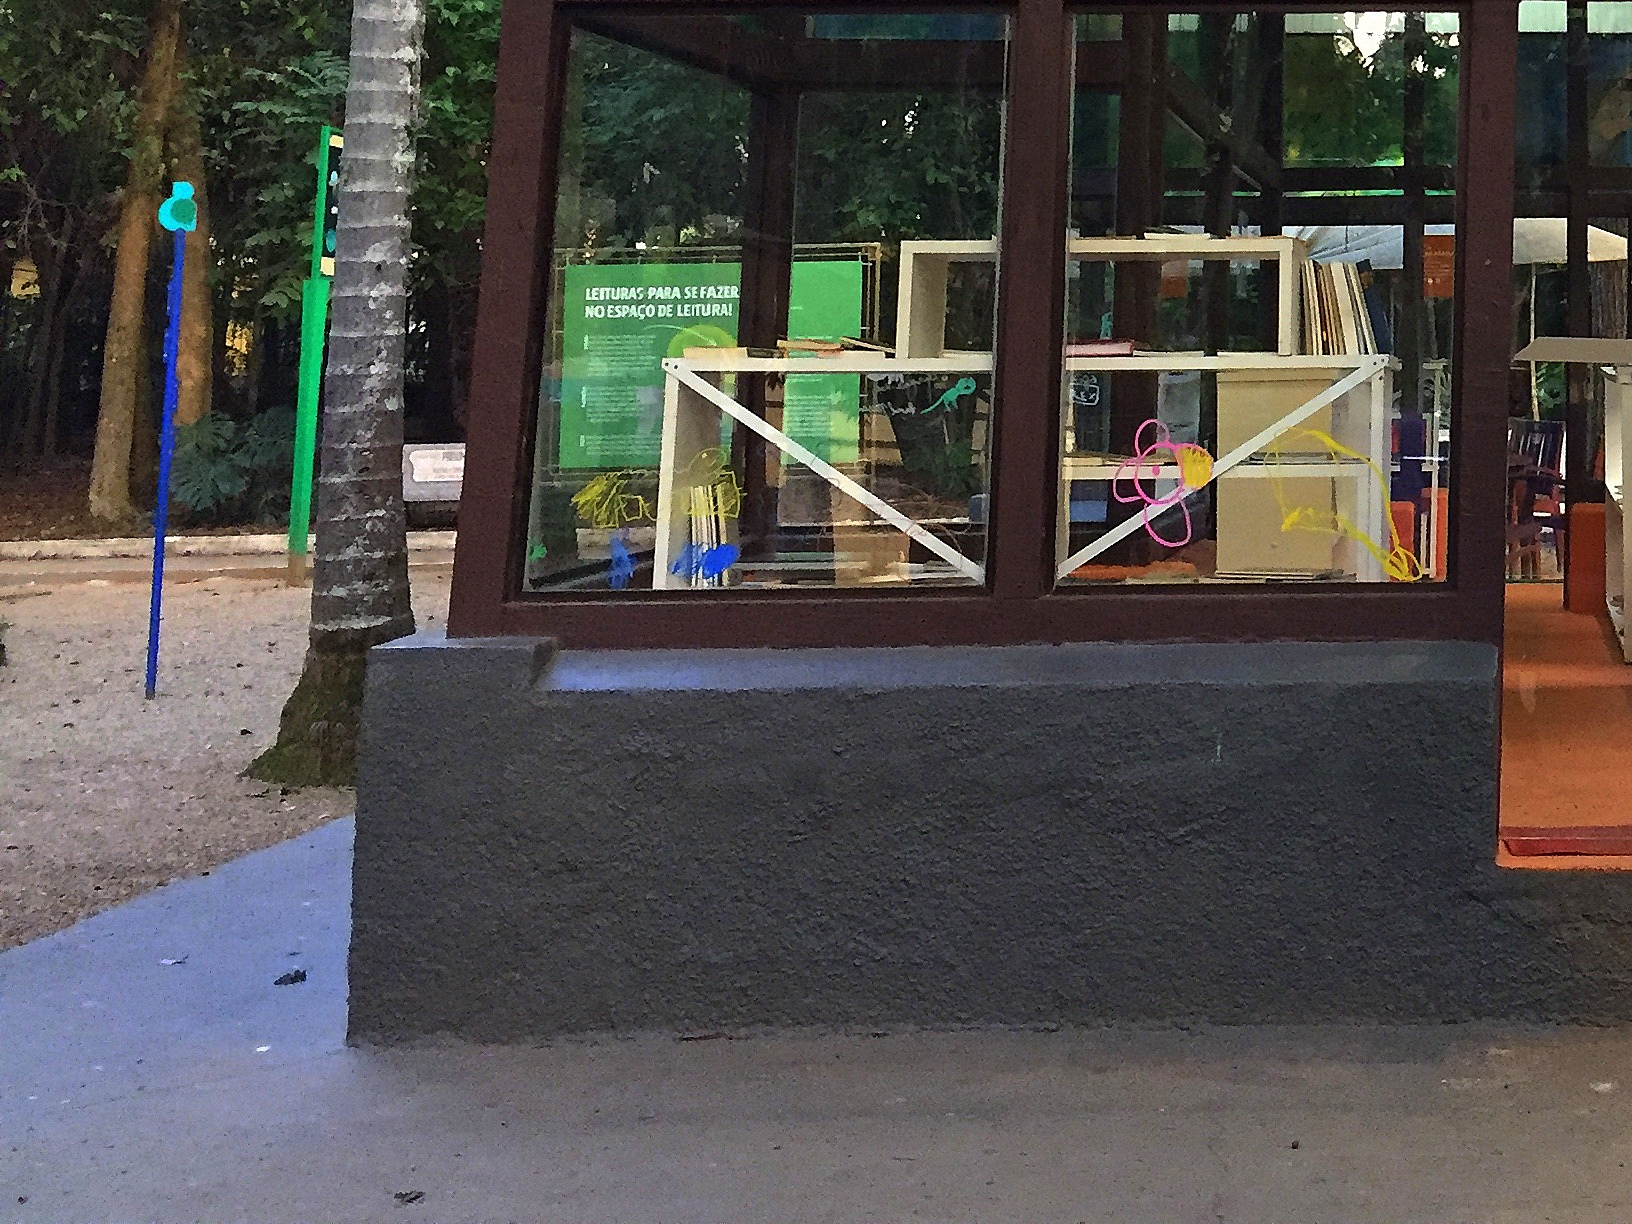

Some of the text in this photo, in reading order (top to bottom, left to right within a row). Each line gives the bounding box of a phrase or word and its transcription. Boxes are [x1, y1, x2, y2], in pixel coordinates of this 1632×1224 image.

[585, 285, 740, 300] LEITURAS PARA SE FAZER
[585, 303, 733, 320] NO ESPAÇO DE LEITURA!
